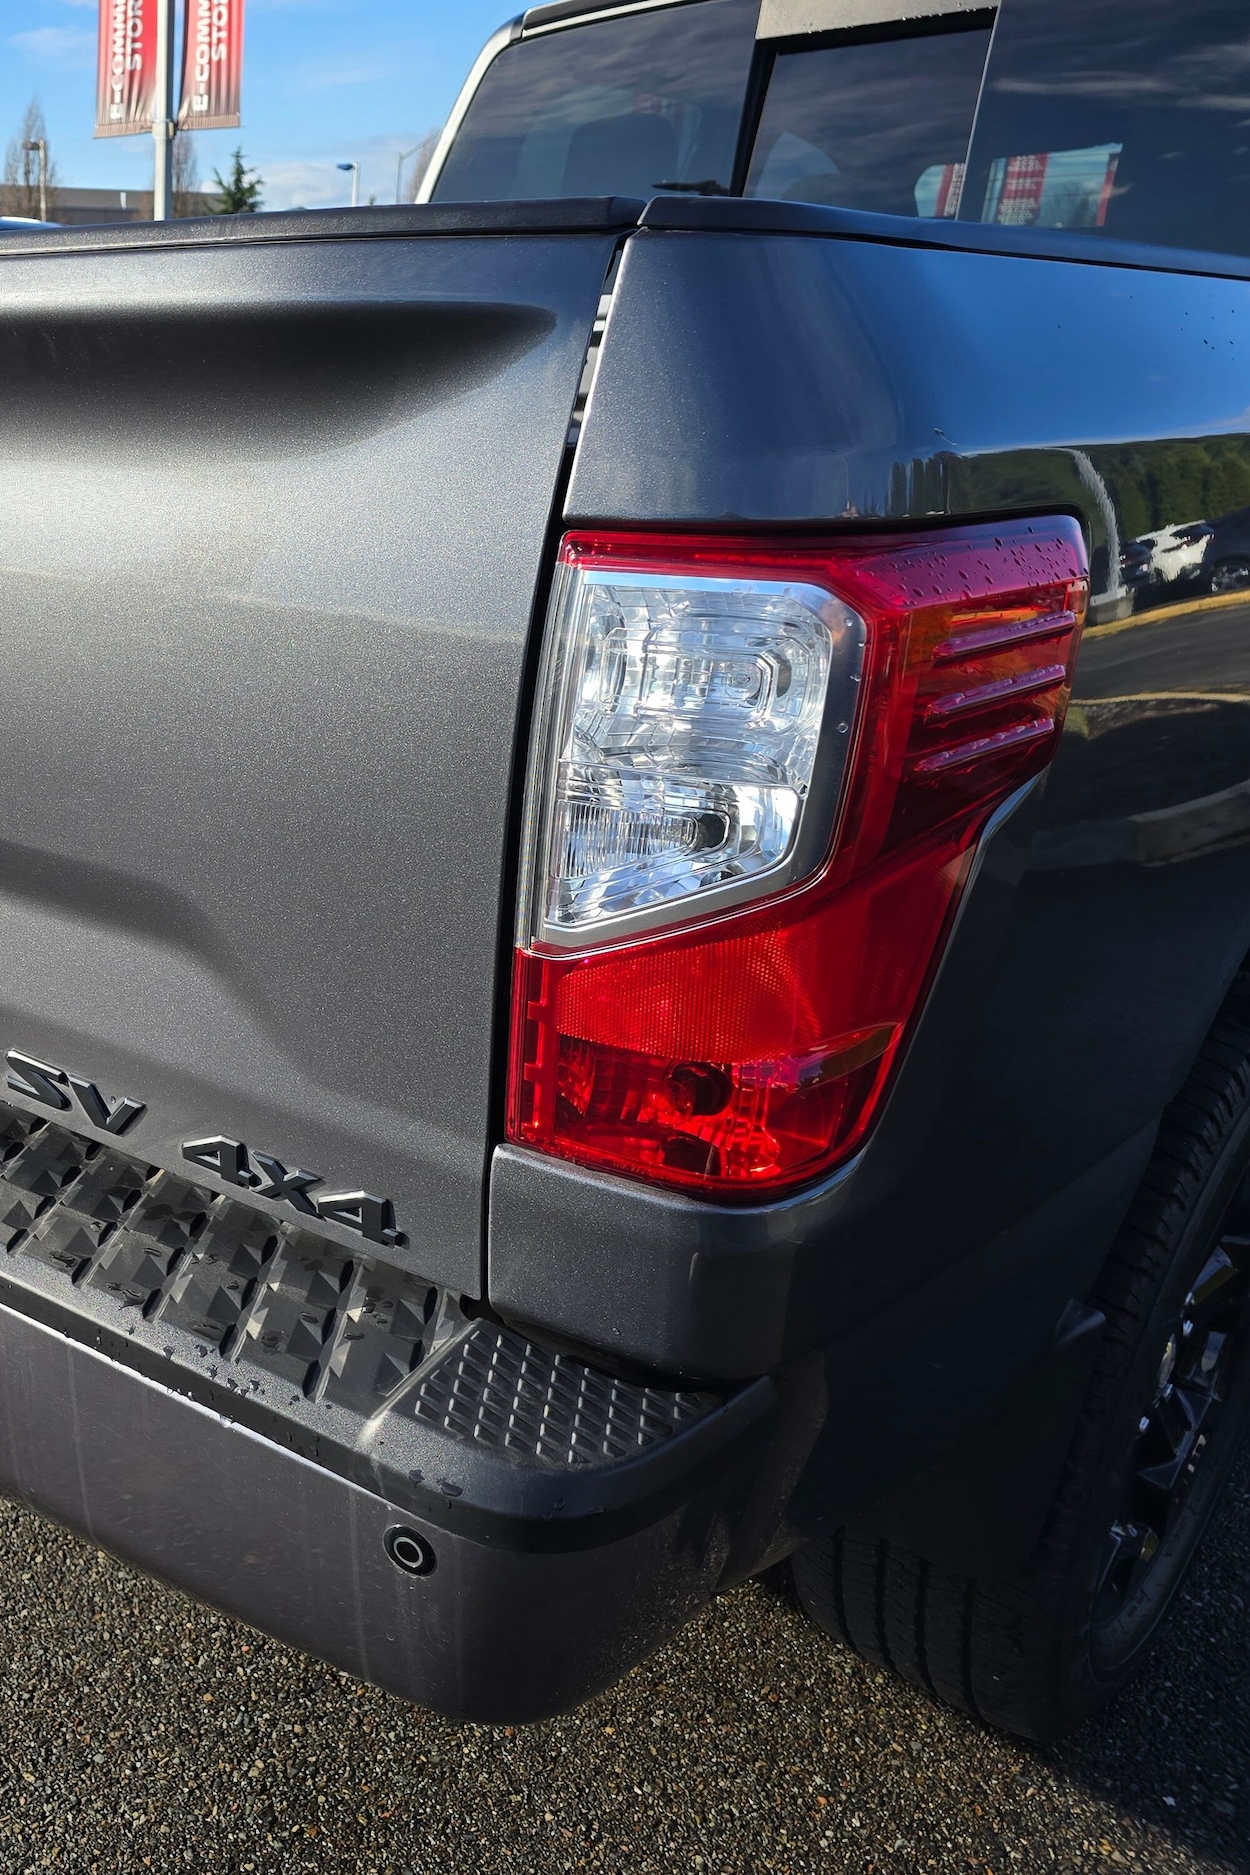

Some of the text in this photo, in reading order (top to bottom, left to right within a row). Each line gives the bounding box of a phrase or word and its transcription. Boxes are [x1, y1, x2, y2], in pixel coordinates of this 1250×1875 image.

[110, 0, 126, 119] E-COMM
[211, 0, 229, 61] STO
[6, 1049, 147, 1135] SV
